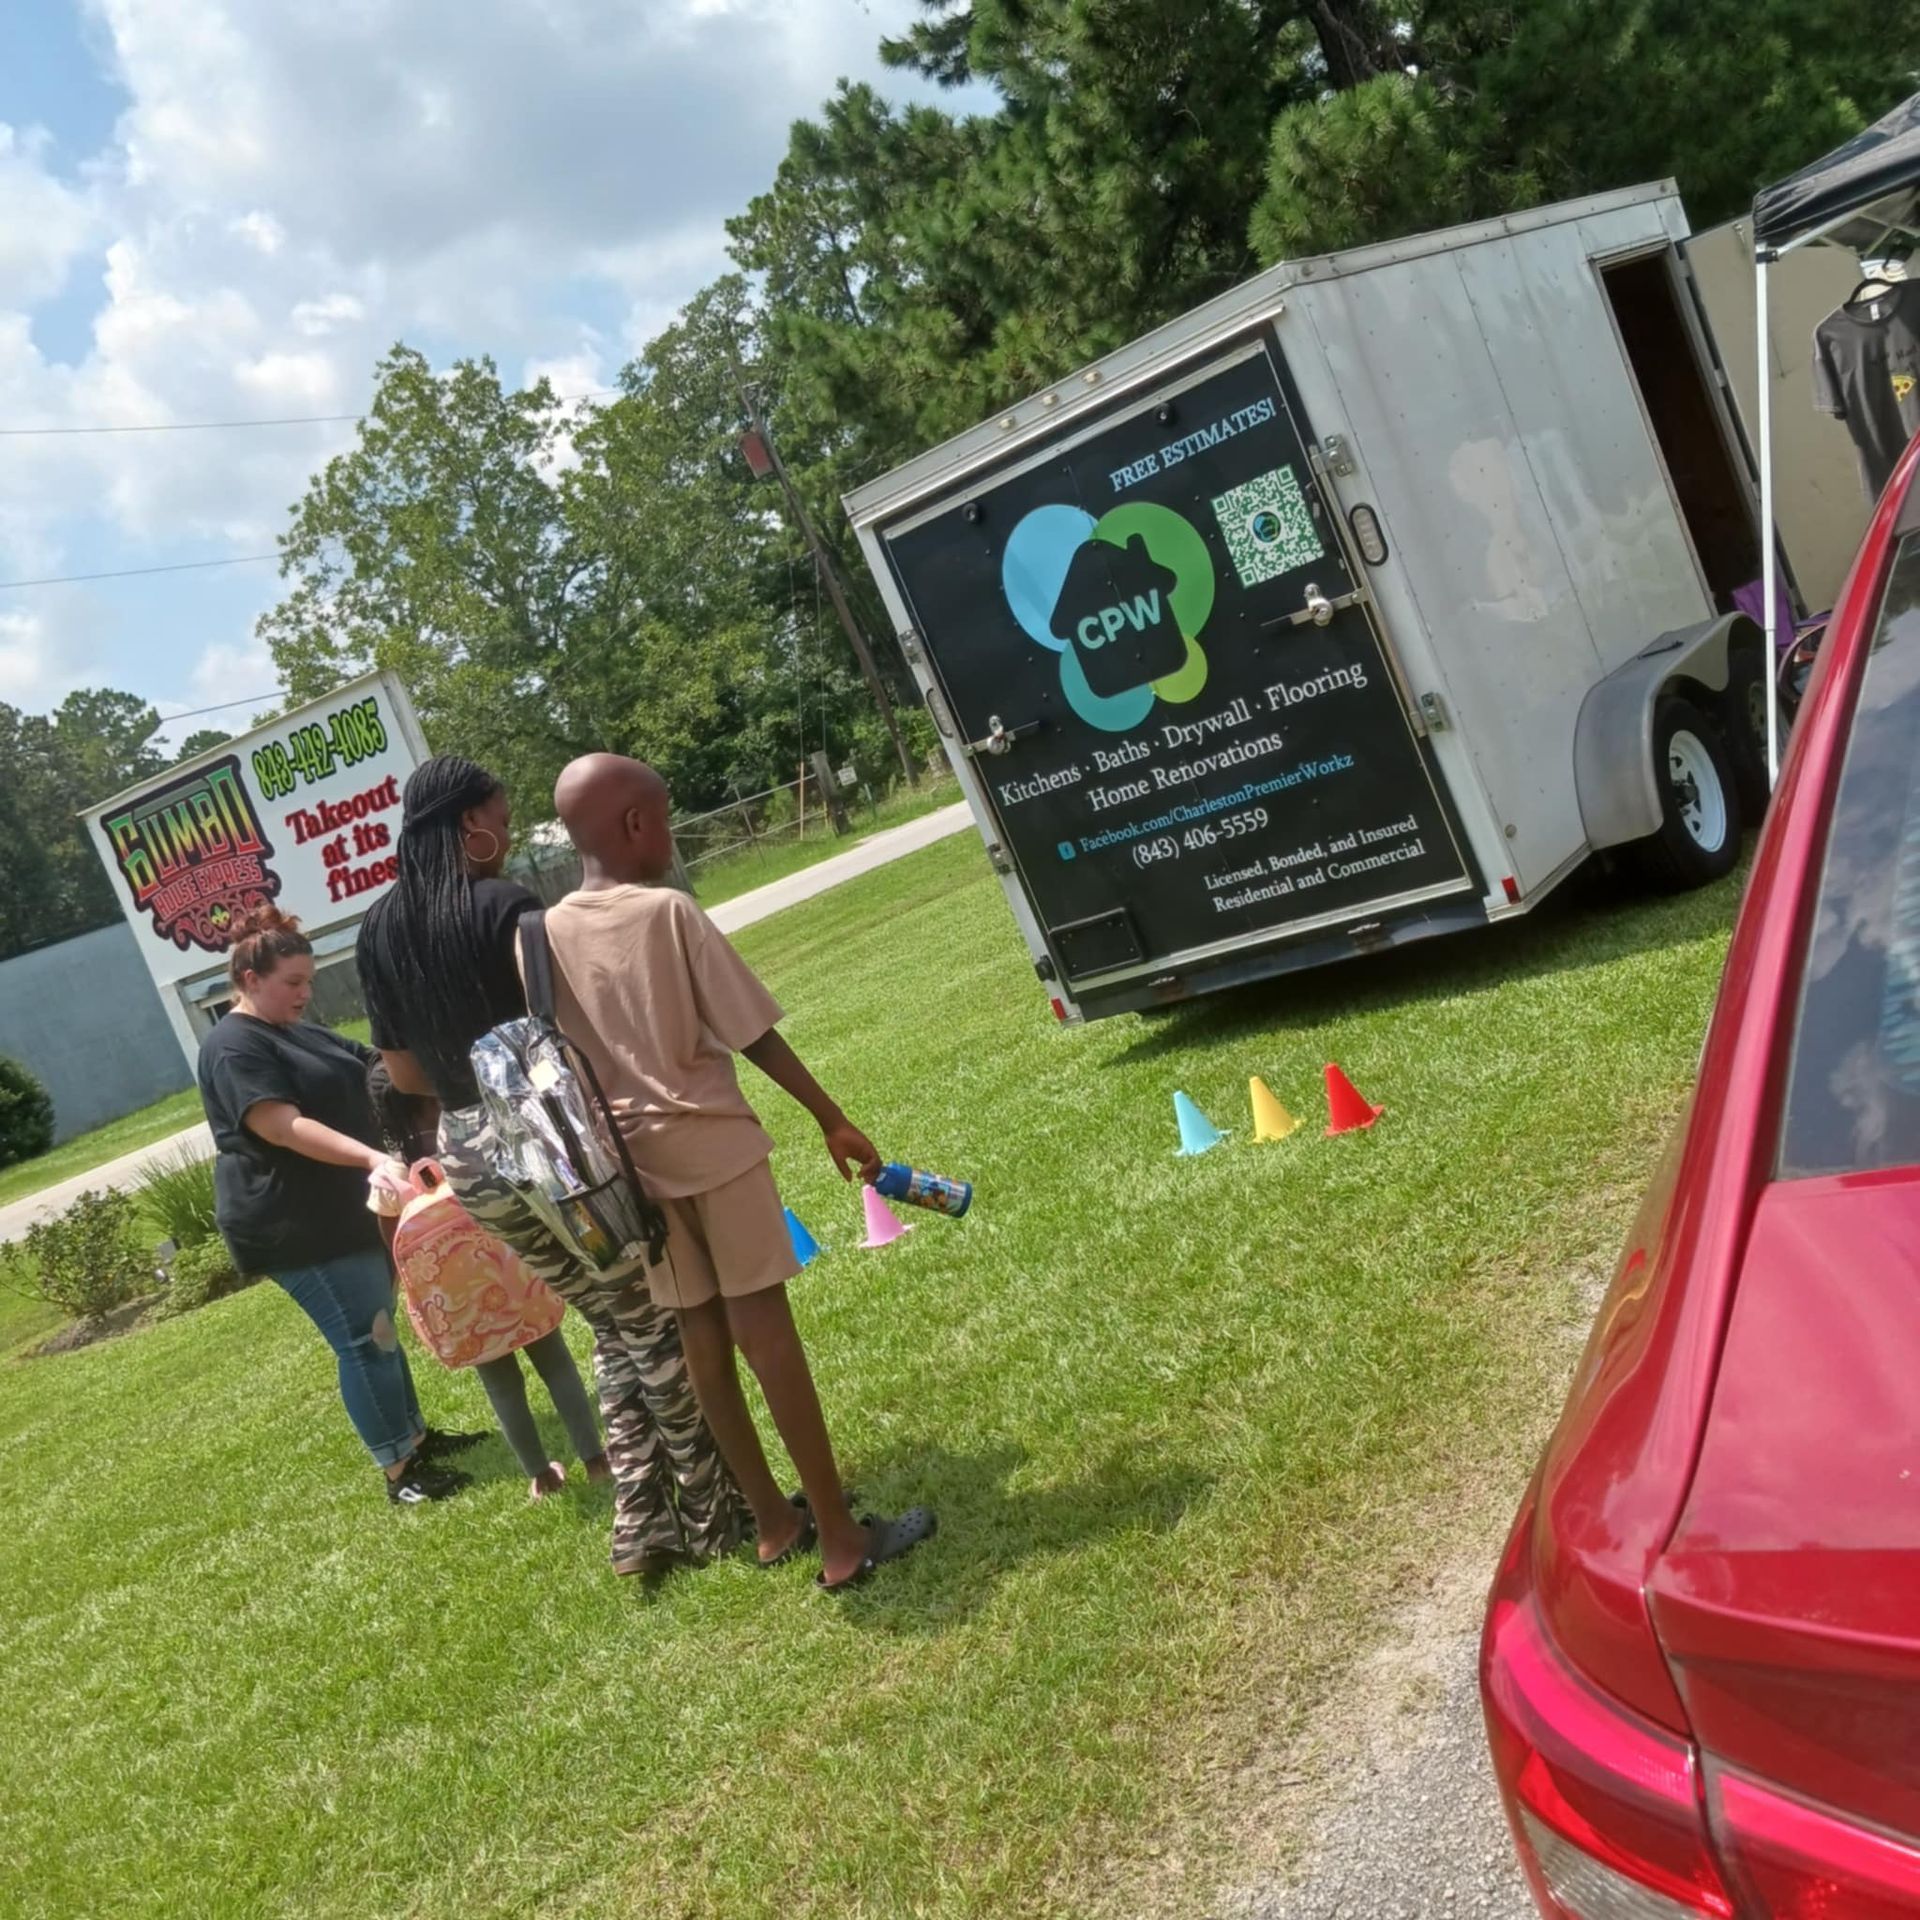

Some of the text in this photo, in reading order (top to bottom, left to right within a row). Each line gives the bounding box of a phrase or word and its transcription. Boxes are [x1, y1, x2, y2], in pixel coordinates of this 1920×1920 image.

[1109, 397, 1277, 492] FREE ESTIMATES!
[1077, 588, 1161, 650] CPW
[252, 696, 388, 801] 843-442-4085
[998, 663, 1368, 807] Kitchens Baths Drywall Flooring
[1087, 732, 1284, 812] Home Renovations
[107, 765, 266, 902] GUMBO
[285, 774, 401, 845] Takeout
[1080, 754, 1355, 852] Facebook.com/CharlestonPremierWorkz
[1132, 807, 1269, 870] (843) 406-5559
[322, 822, 391, 868] at its
[326, 853, 400, 903] fines
[1204, 814, 1419, 890] Licensed, Bonded, and Insured
[1212, 838, 1427, 912] Residential and Commercial
[151, 854, 264, 917] HOUSE EXPRESS
